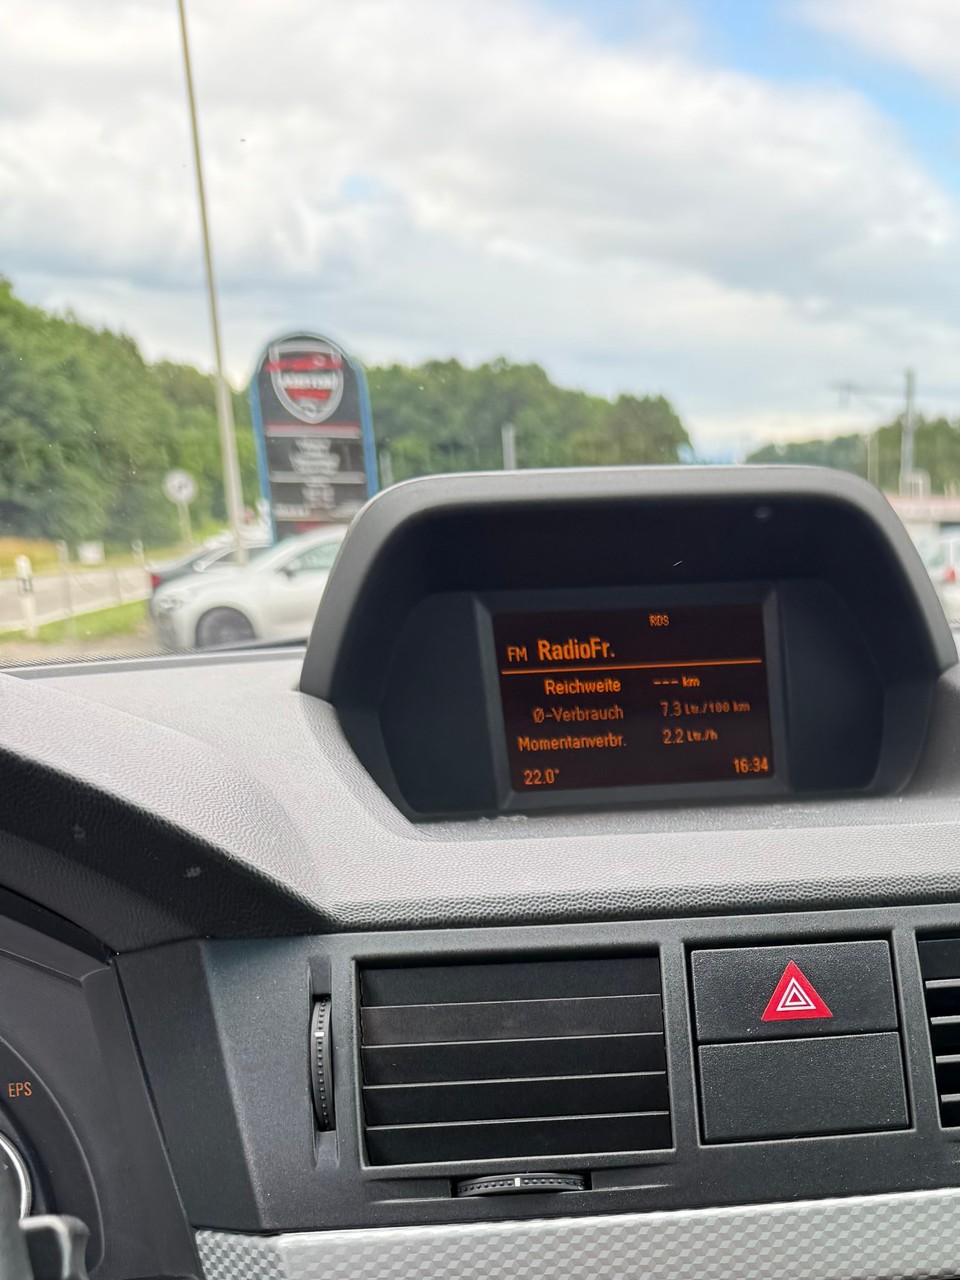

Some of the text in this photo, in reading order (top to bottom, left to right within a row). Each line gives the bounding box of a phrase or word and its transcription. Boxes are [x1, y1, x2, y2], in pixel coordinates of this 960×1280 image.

[507, 637, 616, 662] FM RadioFr.
[544, 677, 621, 695] Reichweite
[682, 675, 700, 687] km
[532, 704, 624, 724] Ø-Verbrauch
[661, 701, 682, 717] 7.3
[733, 700, 750, 712] km
[517, 732, 627, 751] Momentanverbr.
[662, 728, 684, 744] 2.2
[734, 756, 769, 773] 16:34
[8, 1081, 32, 1098] EPS
